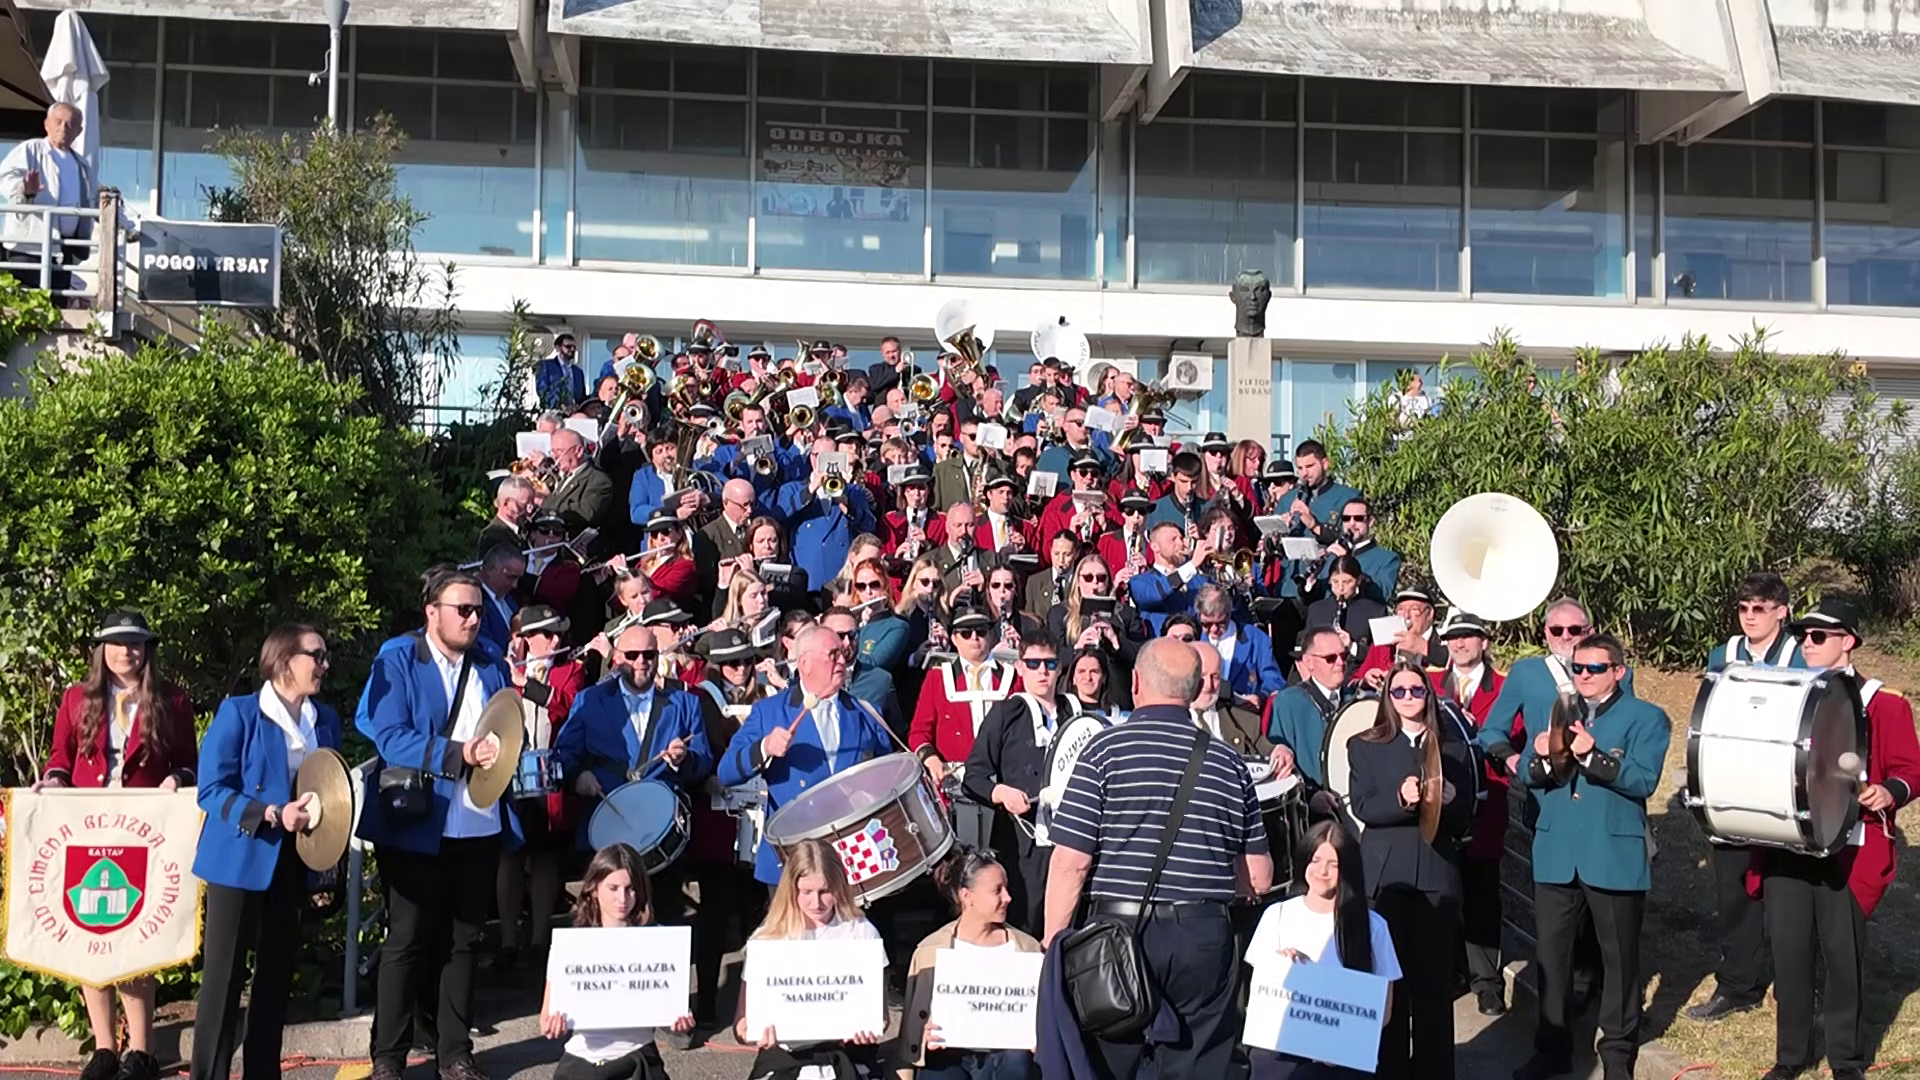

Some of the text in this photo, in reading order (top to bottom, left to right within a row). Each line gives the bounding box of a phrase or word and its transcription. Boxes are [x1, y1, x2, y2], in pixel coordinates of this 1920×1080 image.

[769, 127, 903, 146] ODBOJKA
[769, 143, 904, 159] SUPERLIGA
[143, 254, 269, 274] POGON TRSAT
[87, 847, 124, 857] KASTAV
[33, 905, 69, 943] KUD
[87, 940, 113, 955] 1921
[564, 962, 676, 975] GRADSKA GLAZBA
[628, 980, 669, 990] RIJEKA
[766, 975, 864, 987] LIMENA GLAZBA
[936, 983, 1002, 996] GLAZBENO
[1258, 984, 1378, 1021] PUHAČKI ORKESTAR
[1289, 1007, 1340, 1028] LOVRAN
